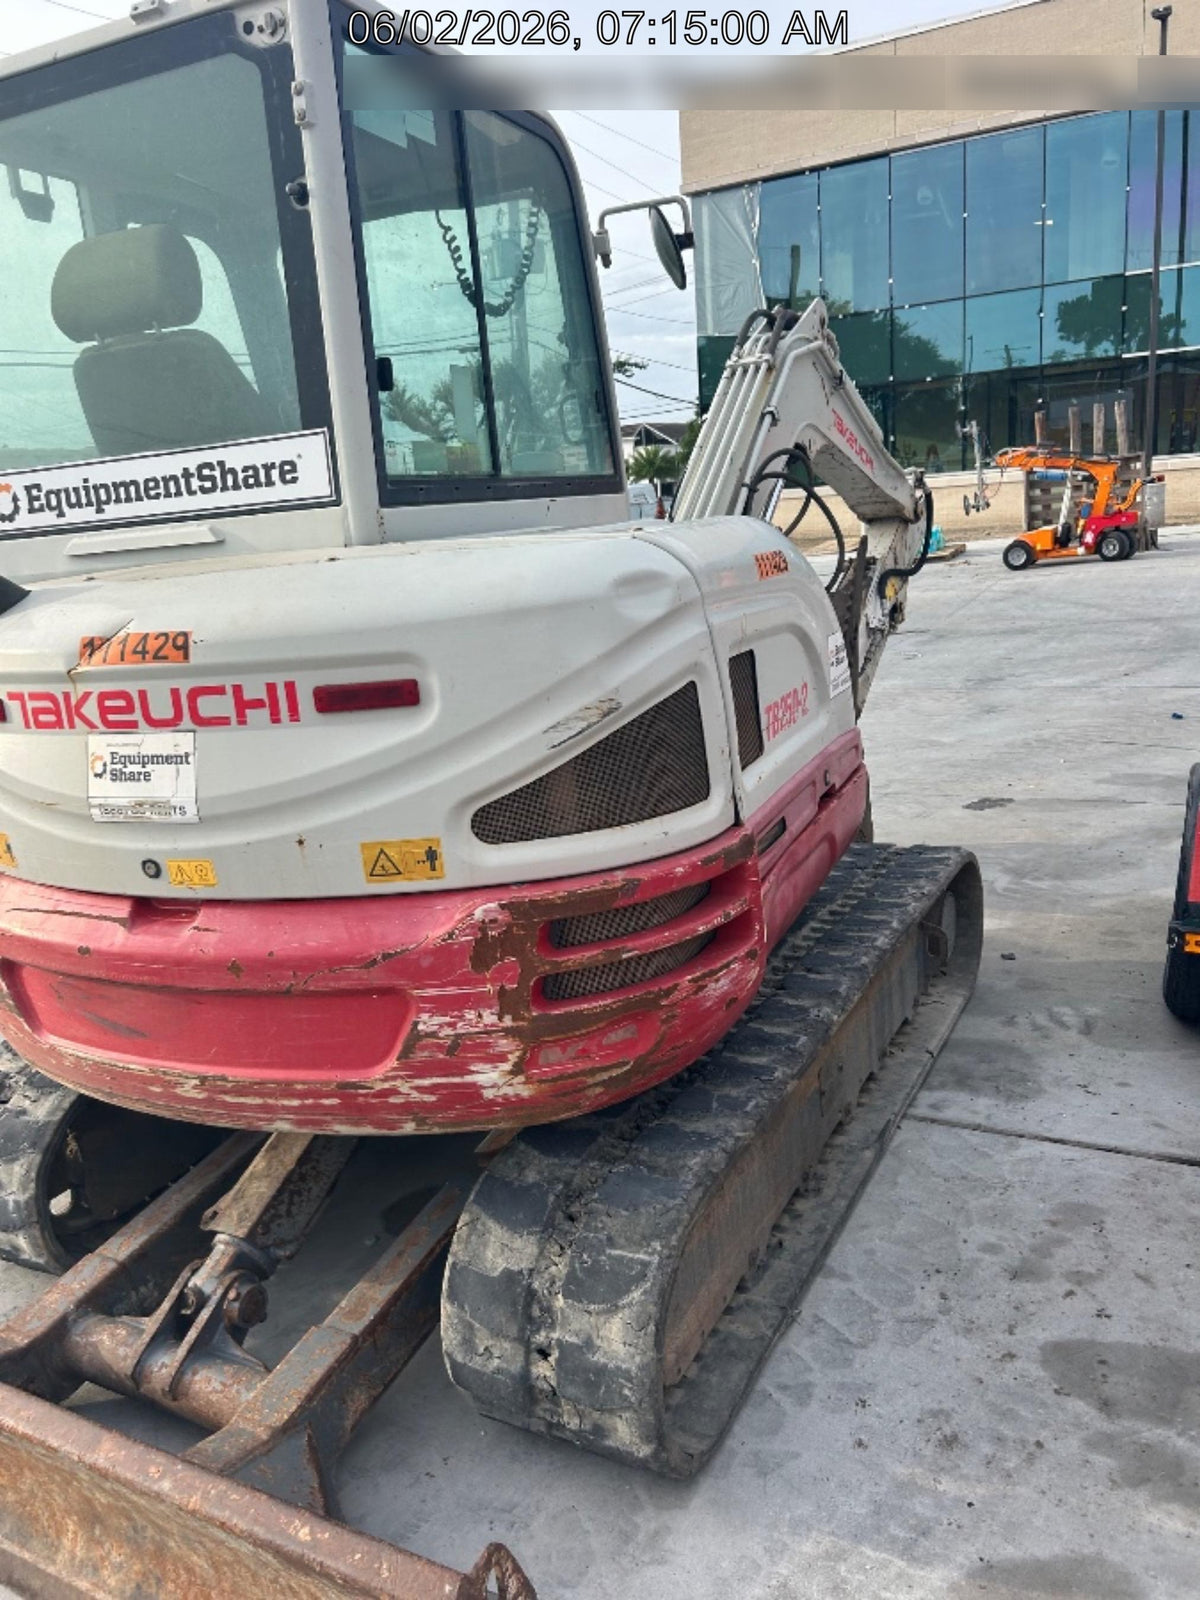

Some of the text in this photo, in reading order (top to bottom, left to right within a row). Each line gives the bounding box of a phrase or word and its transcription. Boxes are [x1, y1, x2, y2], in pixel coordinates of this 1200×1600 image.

[24, 458, 299, 518] EquipmentShare
[109, 751, 191, 769] Equipment
[109, 767, 152, 782] Share
